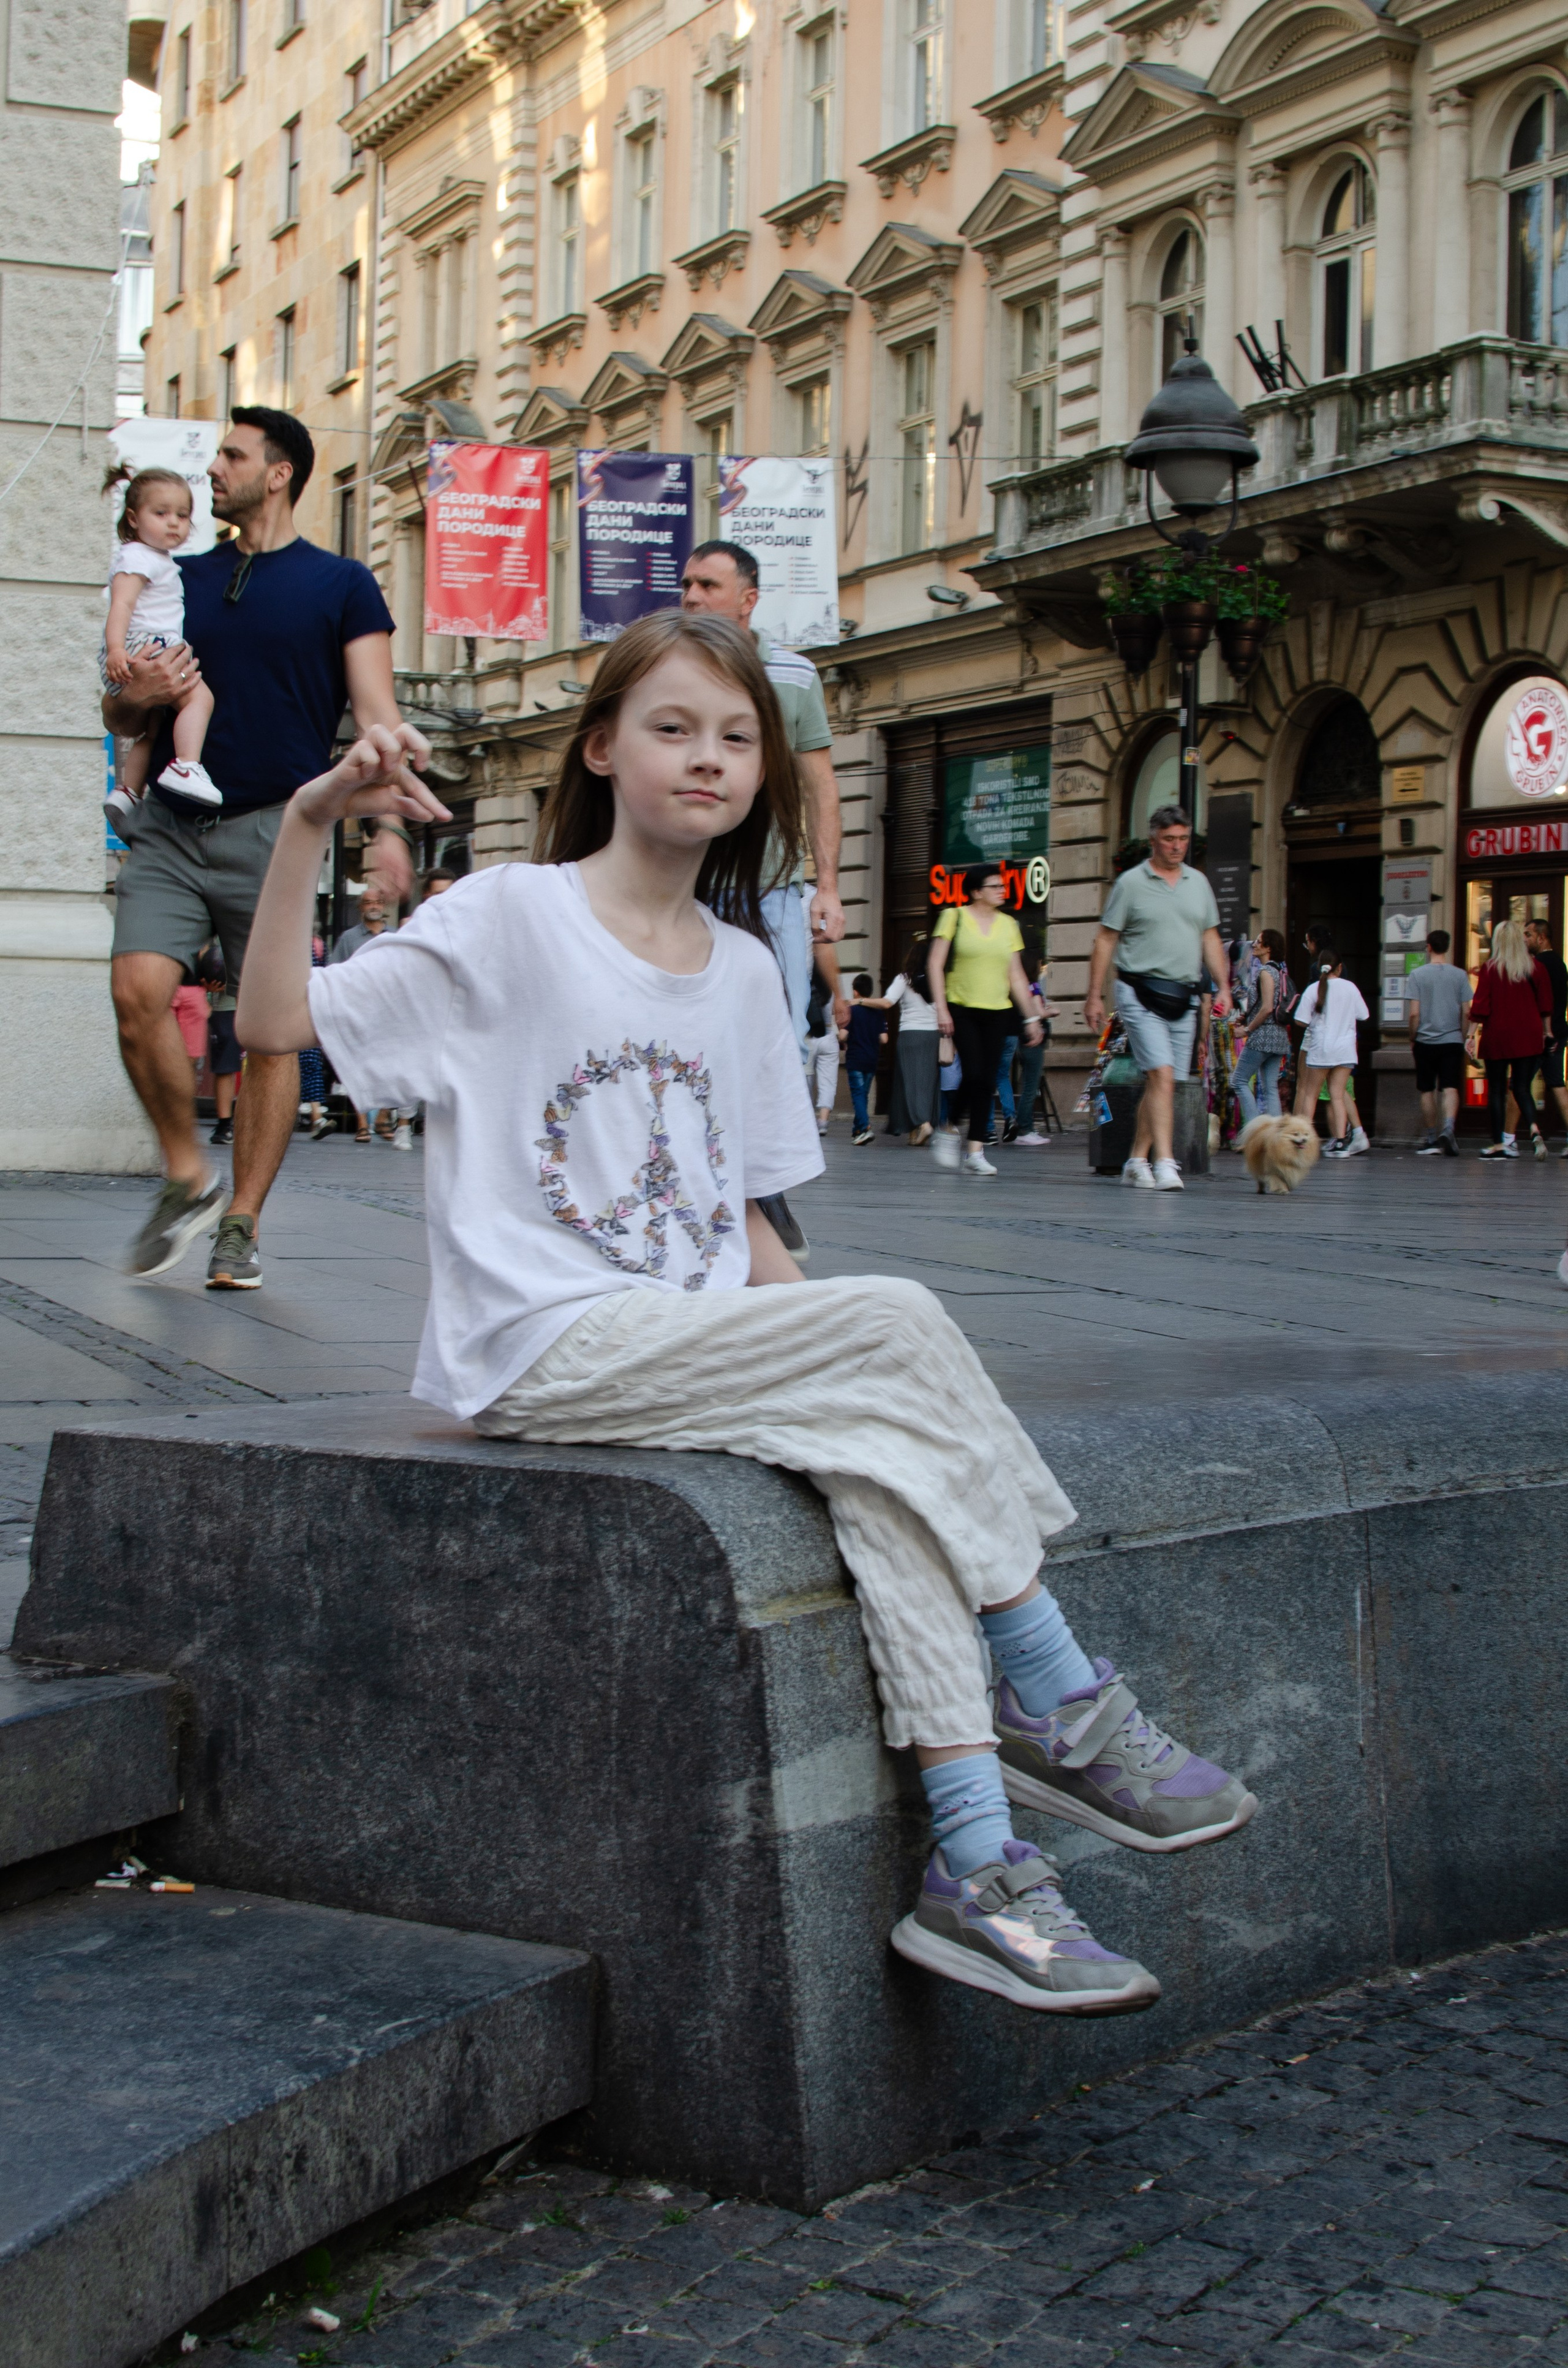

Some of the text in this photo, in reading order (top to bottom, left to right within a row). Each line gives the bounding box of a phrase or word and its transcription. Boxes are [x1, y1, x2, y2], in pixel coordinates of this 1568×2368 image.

[437, 491, 541, 510] БЕОГРАДСКИ
[586, 500, 687, 515] БЕОГРАДСКИ
[437, 506, 485, 520] ДАНИ
[731, 507, 826, 518] БЕОГРАДСКИ
[586, 514, 633, 528] ДАНИ
[731, 521, 775, 532] ДАНИ
[437, 520, 526, 539] ПОРОДИЦЕ
[586, 528, 674, 545] ПОРОДИЦЕ
[731, 535, 813, 547] ПОРОДИЦЕ
[1522, 691, 1567, 746] ANATOMICA
[1516, 765, 1558, 792] GRUBIN
[1467, 823, 1561, 857] GRUBIN
